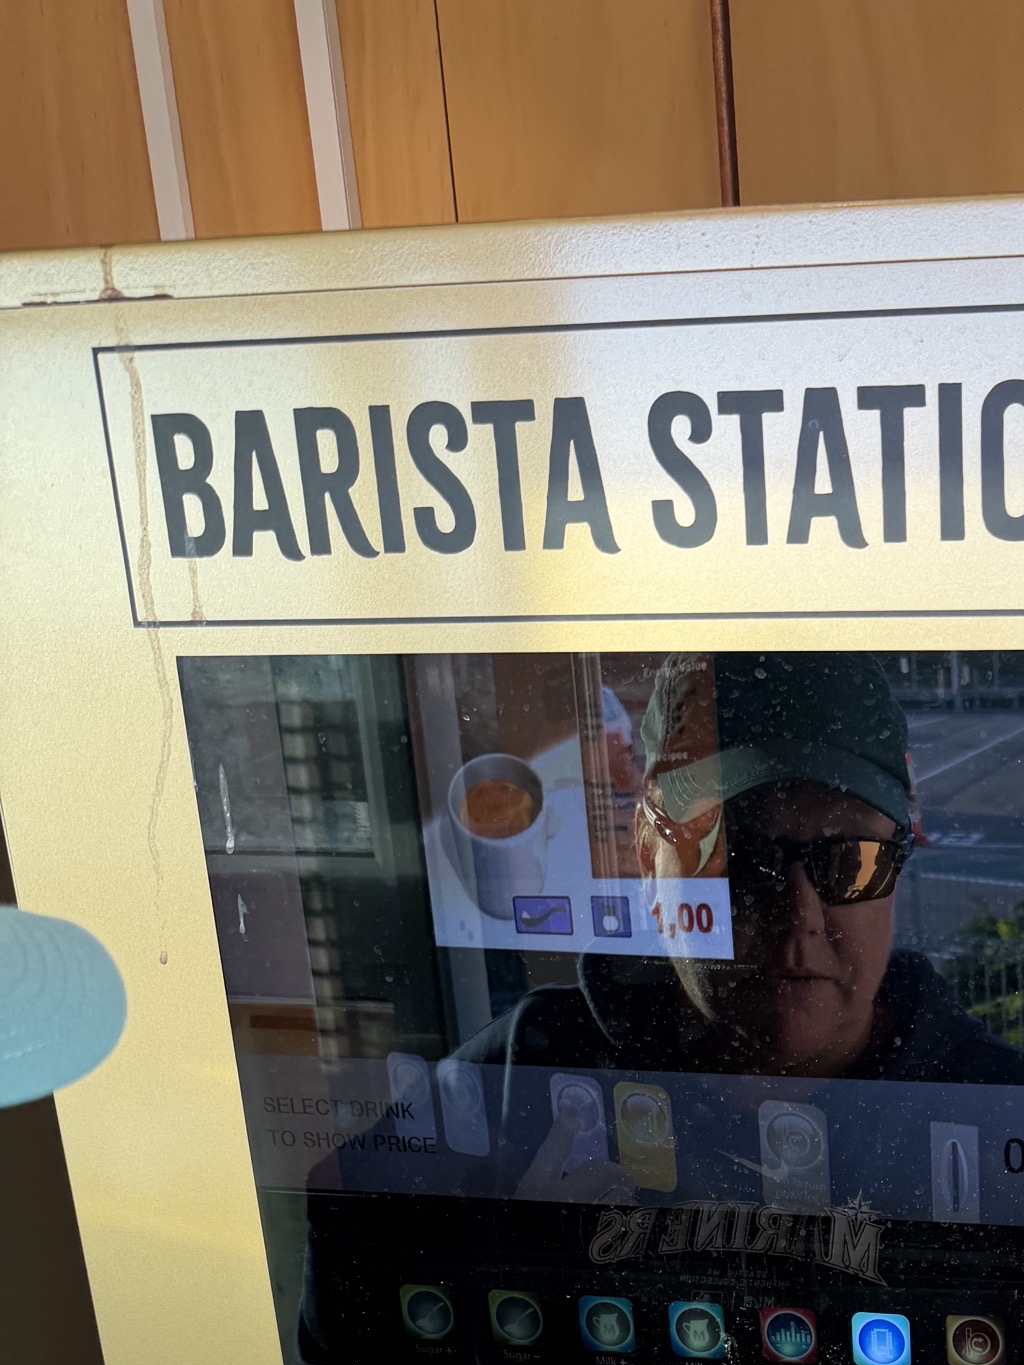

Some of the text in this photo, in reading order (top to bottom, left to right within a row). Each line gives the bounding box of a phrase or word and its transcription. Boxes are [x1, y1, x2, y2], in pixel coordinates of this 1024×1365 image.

[150, 396, 622, 562] BARISTA
[651, 902, 713, 939] 1,00
[264, 1097, 414, 1119] SELECT DRINK
[267, 1129, 437, 1154] TO SHOW PRICE
[415, 1343, 443, 1356] Sugar
[503, 1349, 531, 1362] Sugar
